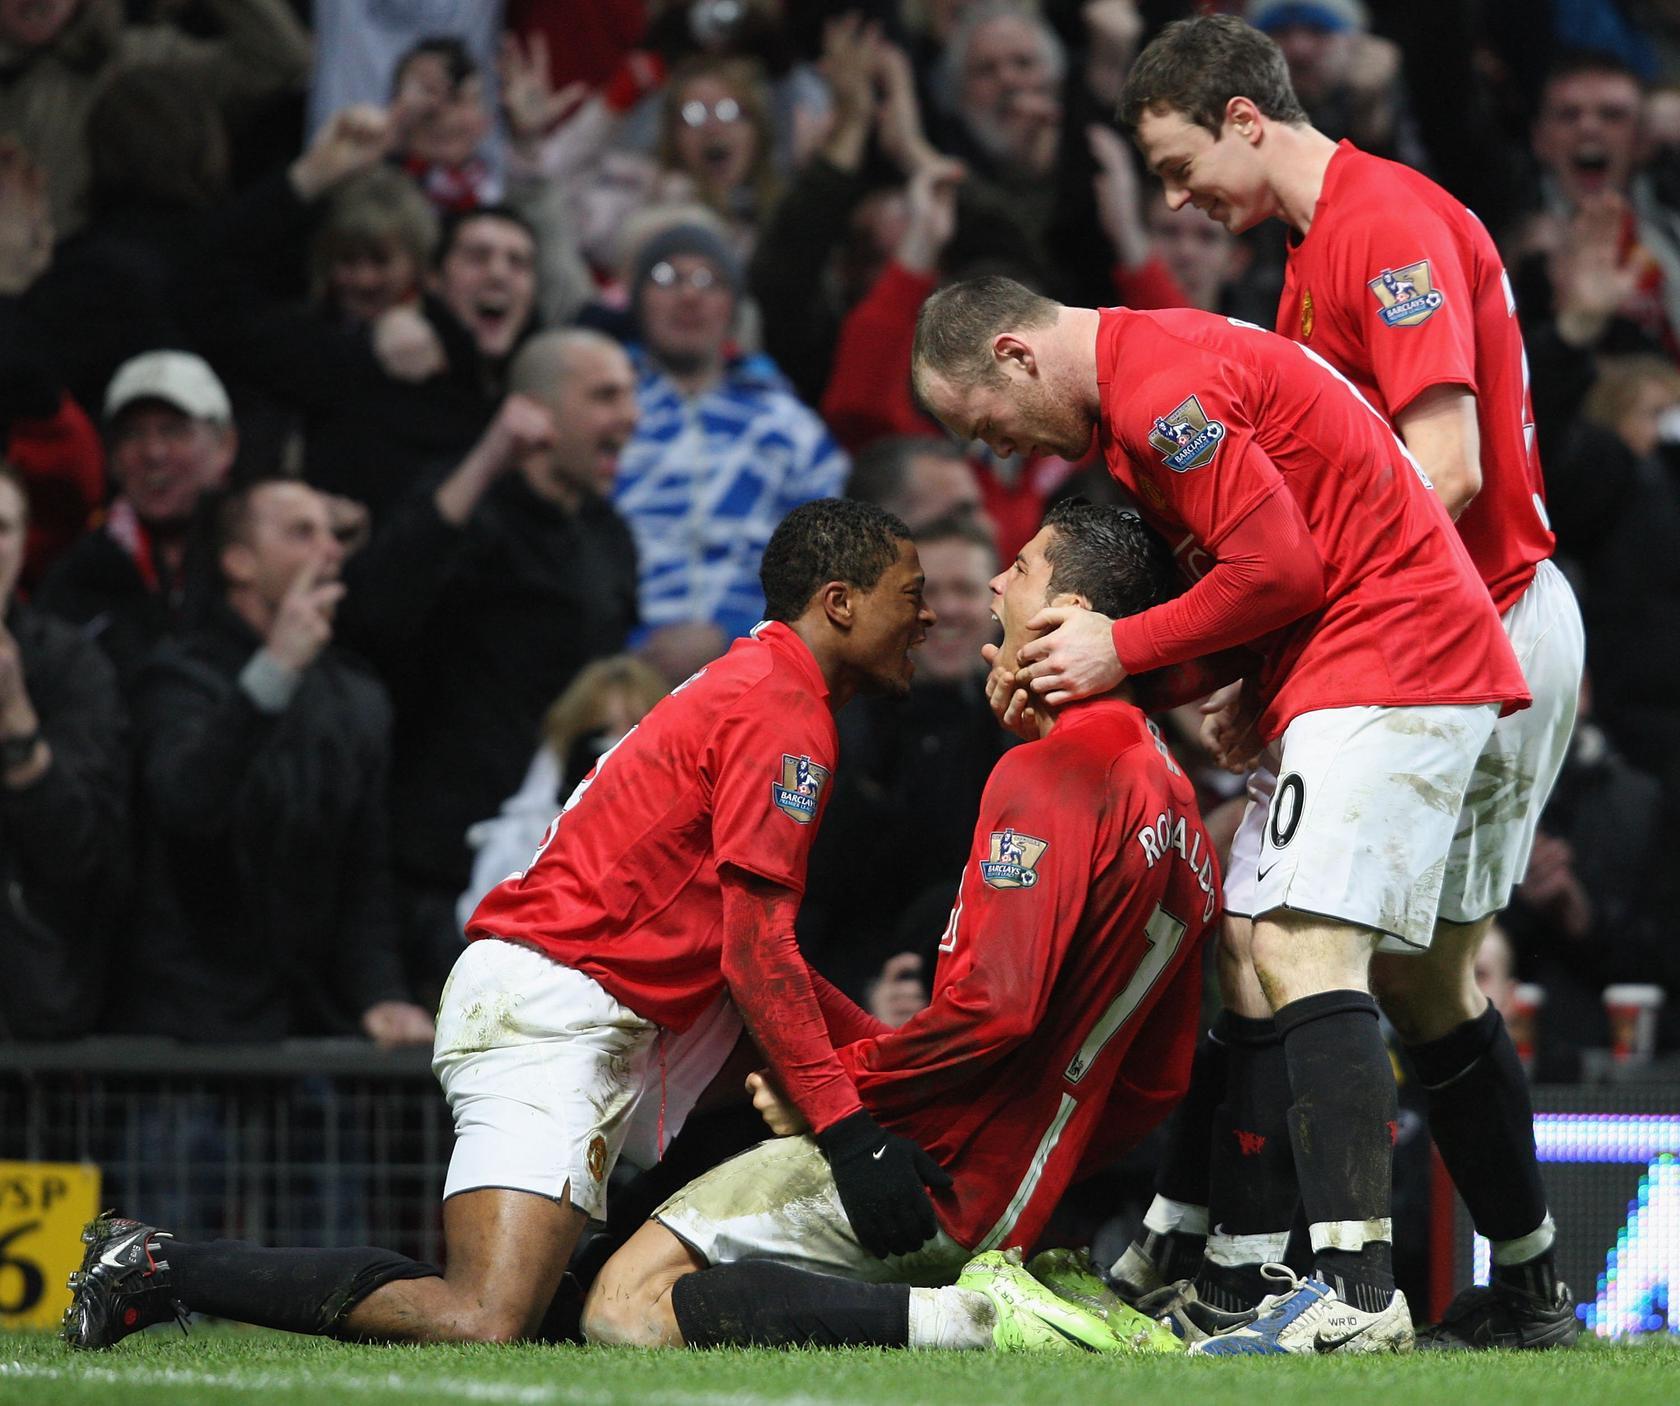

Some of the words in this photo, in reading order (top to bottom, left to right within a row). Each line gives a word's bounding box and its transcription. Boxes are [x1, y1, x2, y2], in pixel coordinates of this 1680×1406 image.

[1386, 297, 1426, 317] BARCLAYS
[1174, 432, 1207, 463] BARCLAYS
[1266, 769, 1307, 850] 0
[987, 865, 1021, 876] BARCLAYS
[1138, 808, 1215, 923] ROALDO
[0, 1177, 68, 1211] SP
